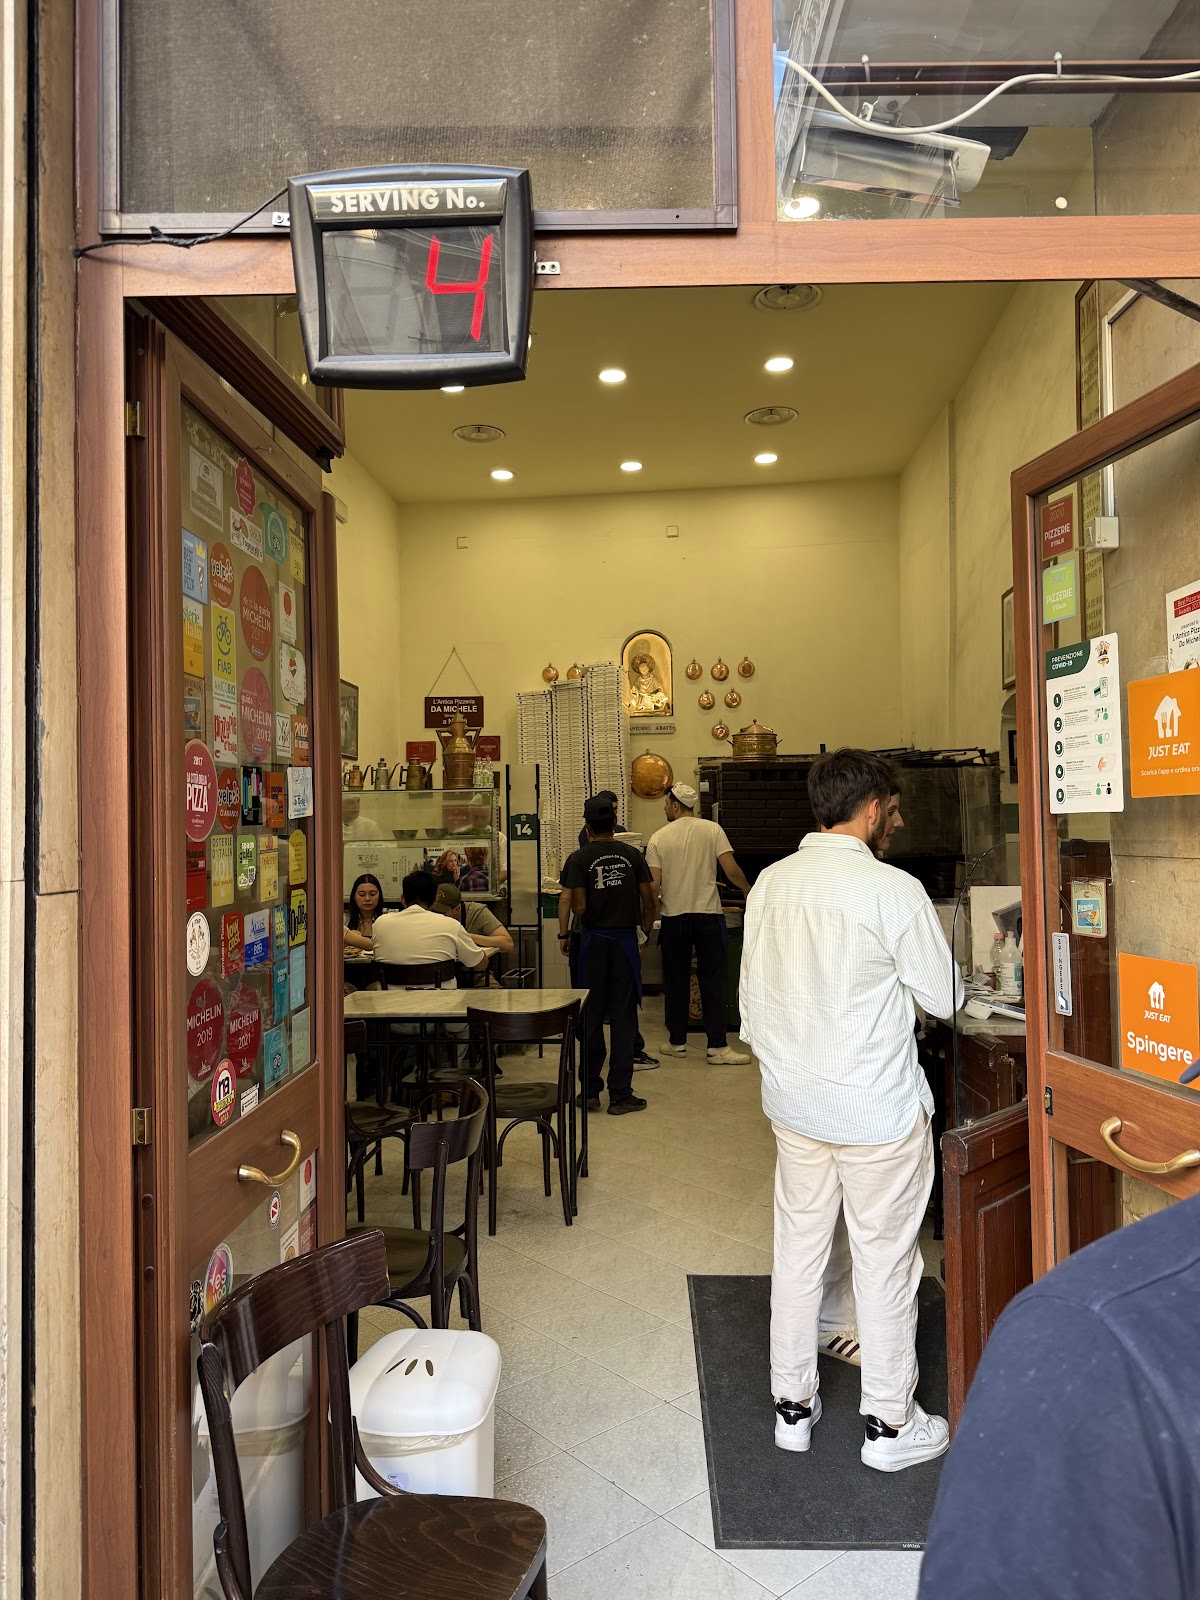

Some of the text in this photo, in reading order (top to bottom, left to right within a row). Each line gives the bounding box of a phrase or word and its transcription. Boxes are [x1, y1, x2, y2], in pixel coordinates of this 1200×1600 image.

[330, 187, 485, 213] SERVING No.
[425, 234, 493, 342] 4
[1044, 522, 1071, 541] PIZZERIE
[1046, 588, 1073, 604] PIZZERIE
[242, 606, 271, 632] MICHELIN
[1051, 650, 1084, 664] PREVENZIONE
[1051, 660, 1073, 671] COVID-19
[217, 659, 232, 675] FIAB
[241, 706, 272, 728] MICHELIN
[430, 705, 478, 713] DA MICHELE
[257, 728, 272, 742] 2012
[1148, 742, 1191, 760] JUST EAT
[193, 755, 203, 767] 2017
[1141, 769, 1157, 777] Scarica
[1158, 768, 1170, 776] l'app
[1174, 766, 1190, 774] ordina
[186, 782, 209, 812] PIZZA
[515, 823, 533, 837] 14
[212, 837, 233, 848] OSTERIE
[606, 879, 622, 887] PIZZA
[186, 1003, 222, 1031] MICHELIN
[229, 1009, 259, 1034] MICHELIN
[1144, 1010, 1171, 1024] JUST EAT
[196, 1026, 213, 1047] 2019
[238, 1032, 251, 1050] 2021
[1127, 1031, 1193, 1066] Spingere
